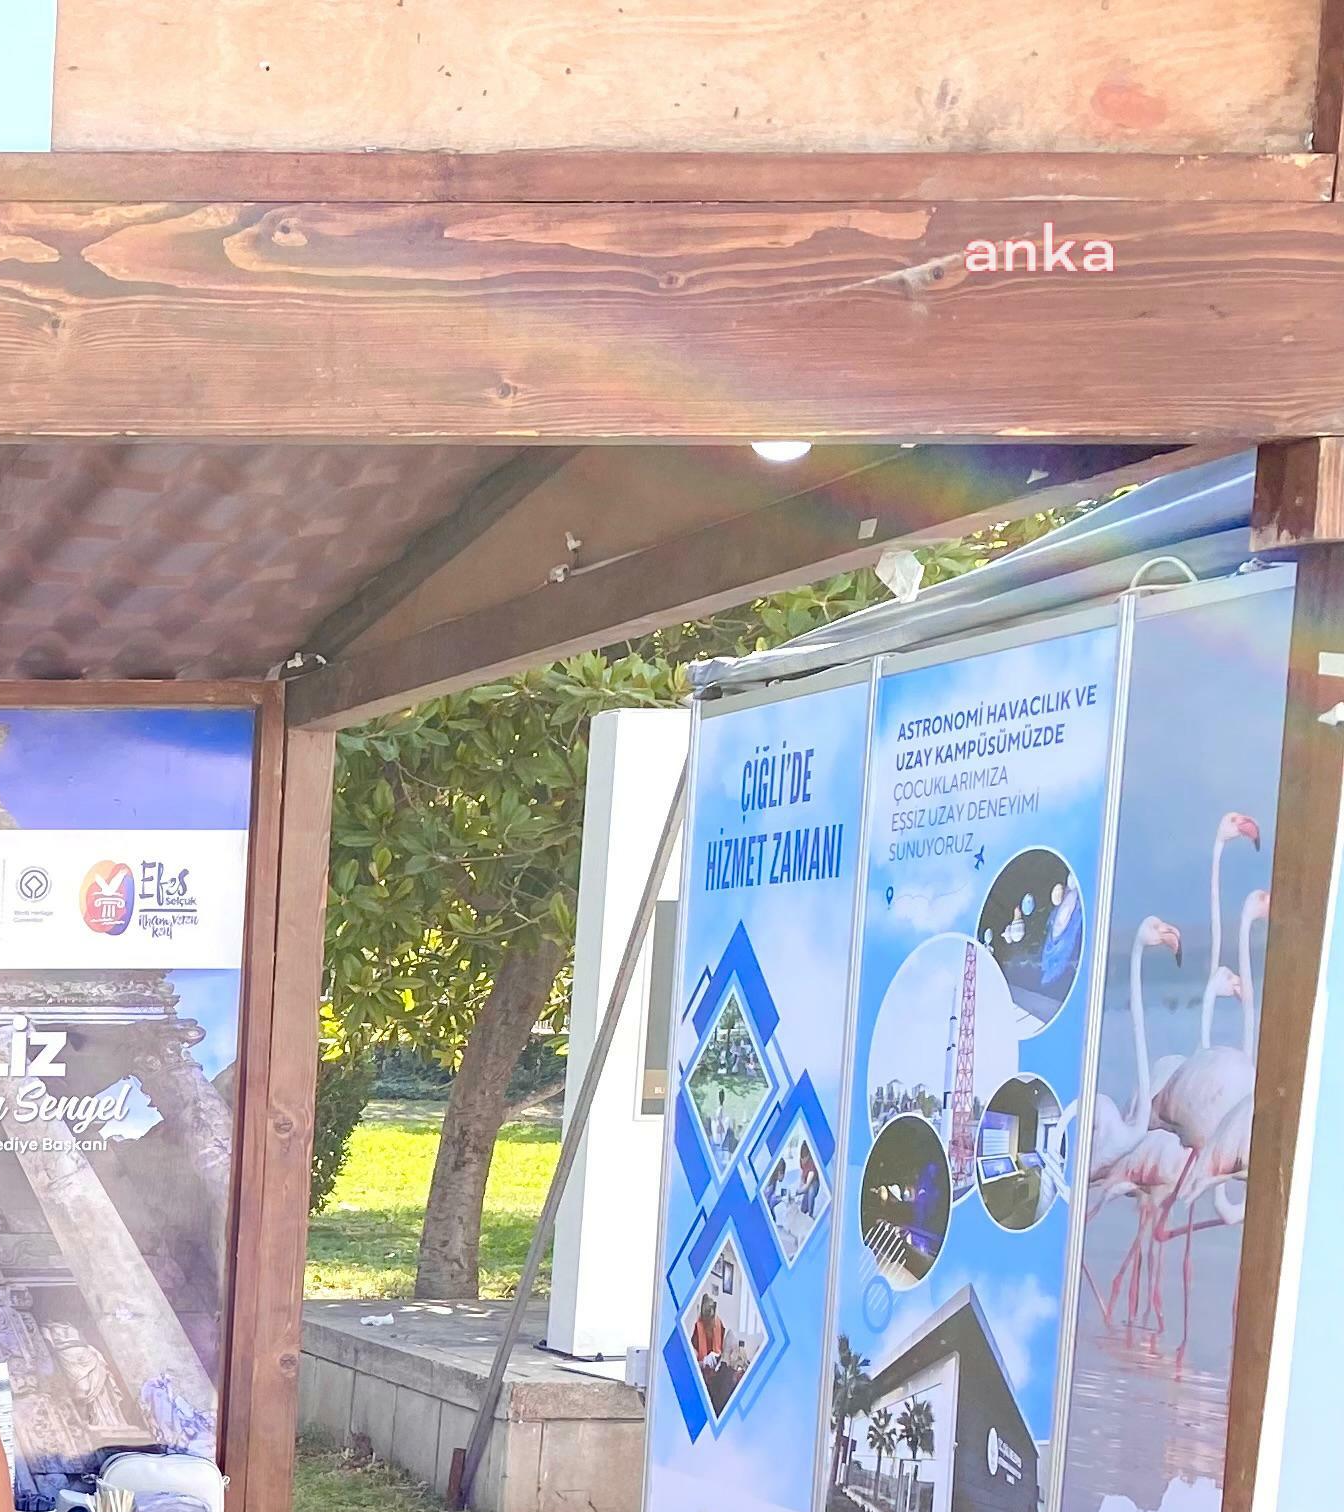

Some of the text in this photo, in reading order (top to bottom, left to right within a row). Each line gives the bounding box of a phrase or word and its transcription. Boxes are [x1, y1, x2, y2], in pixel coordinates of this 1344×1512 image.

[897, 684, 1098, 742] ASTRONOMİ HAVACILIK VE
[895, 723, 1065, 771] UZAY KAMPÜSÜMÜZDE
[893, 767, 1009, 802] ÇOCUKLARIMIZA
[928, 799, 964, 826] UZAY
[966, 790, 1040, 819] DENEYİMİ
[705, 824, 844, 891] HİZMET ZAMANI
[889, 832, 974, 862] SUNUYORUZ
[139, 860, 190, 906] Efes
[42, 1137, 108, 1155] Başkanı
